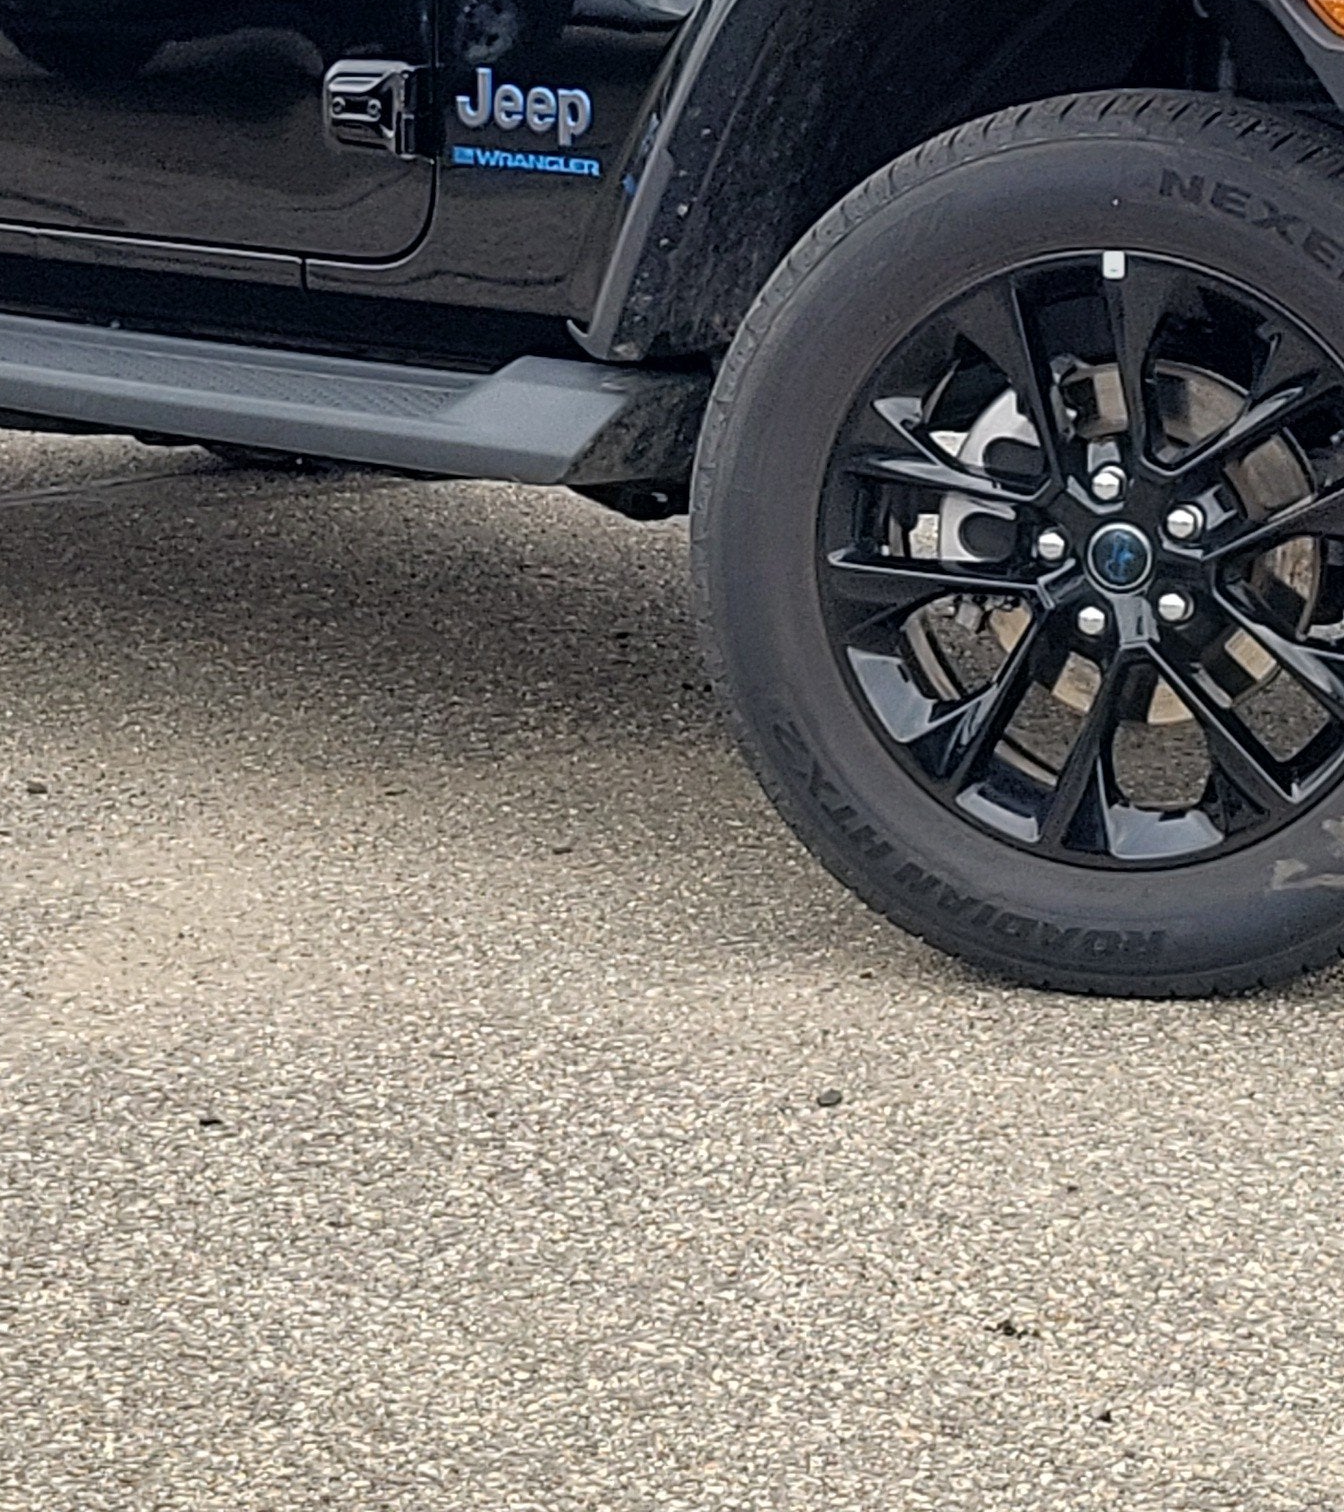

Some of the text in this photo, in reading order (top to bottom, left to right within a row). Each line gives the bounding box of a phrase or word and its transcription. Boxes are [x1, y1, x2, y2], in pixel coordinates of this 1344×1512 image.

[456, 67, 591, 146] Jeep
[476, 149, 601, 176] WRANGLER
[772, 721, 1169, 962] ROADIAN HTX2
